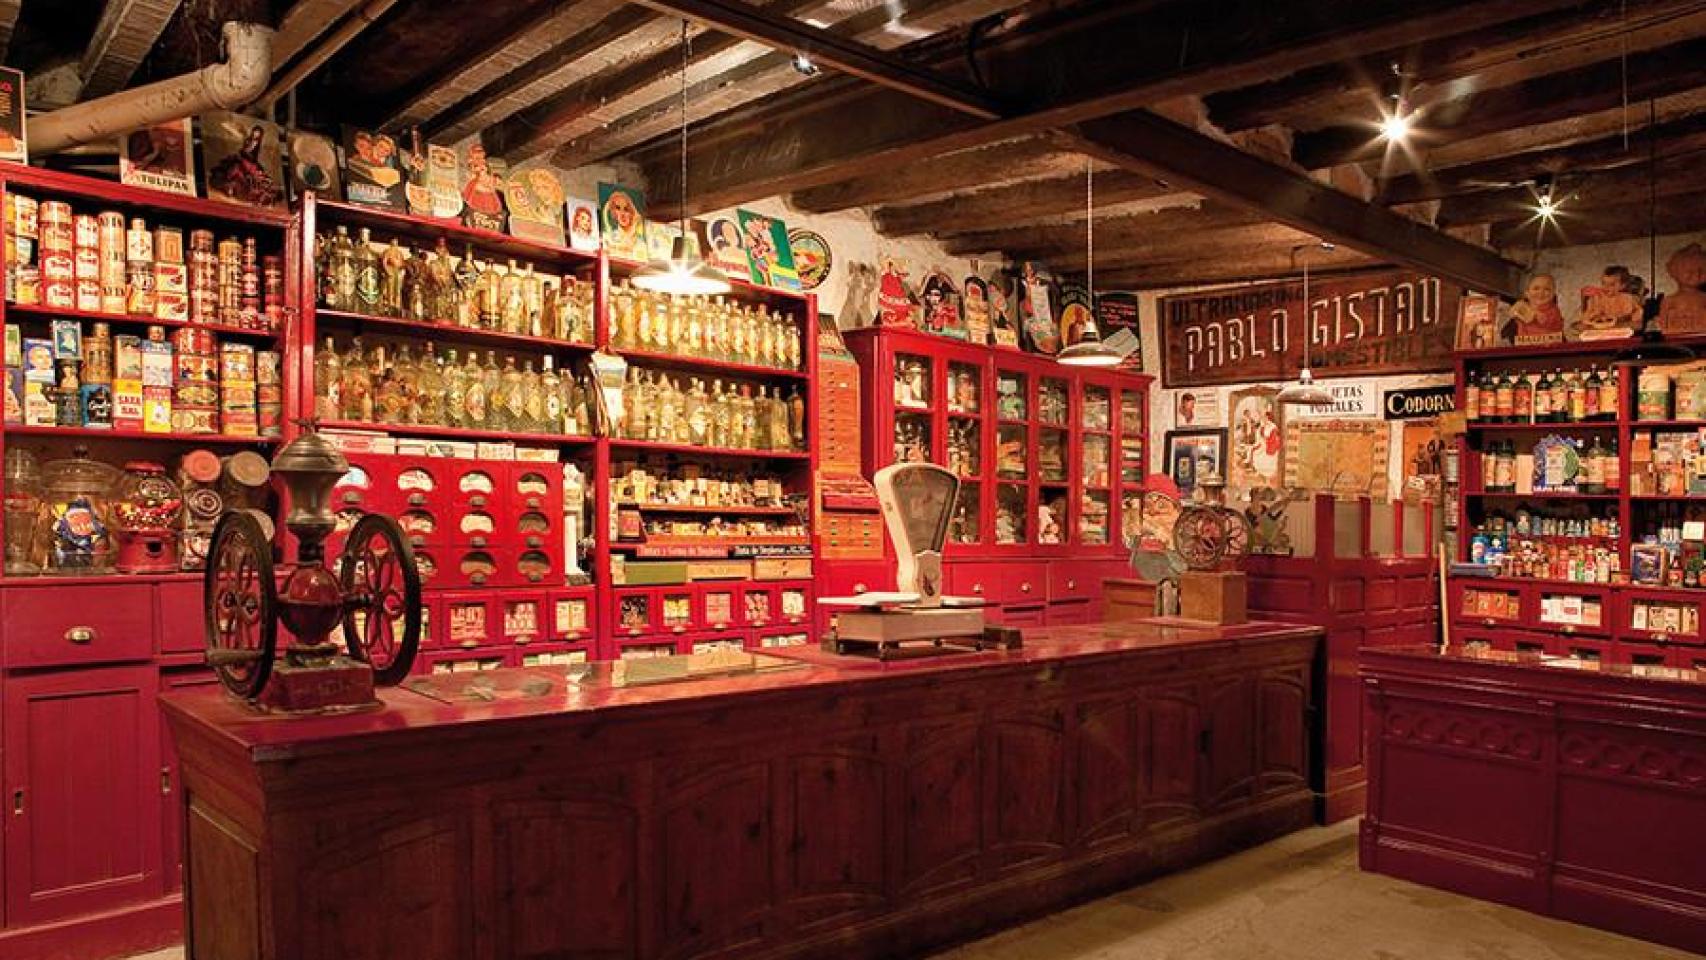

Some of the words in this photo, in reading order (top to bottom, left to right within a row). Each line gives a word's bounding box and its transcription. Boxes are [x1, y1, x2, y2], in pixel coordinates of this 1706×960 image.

[1185, 308, 1288, 372] PABLO
[1311, 277, 1441, 347] GISTAU
[1387, 392, 1455, 415] CODORN
